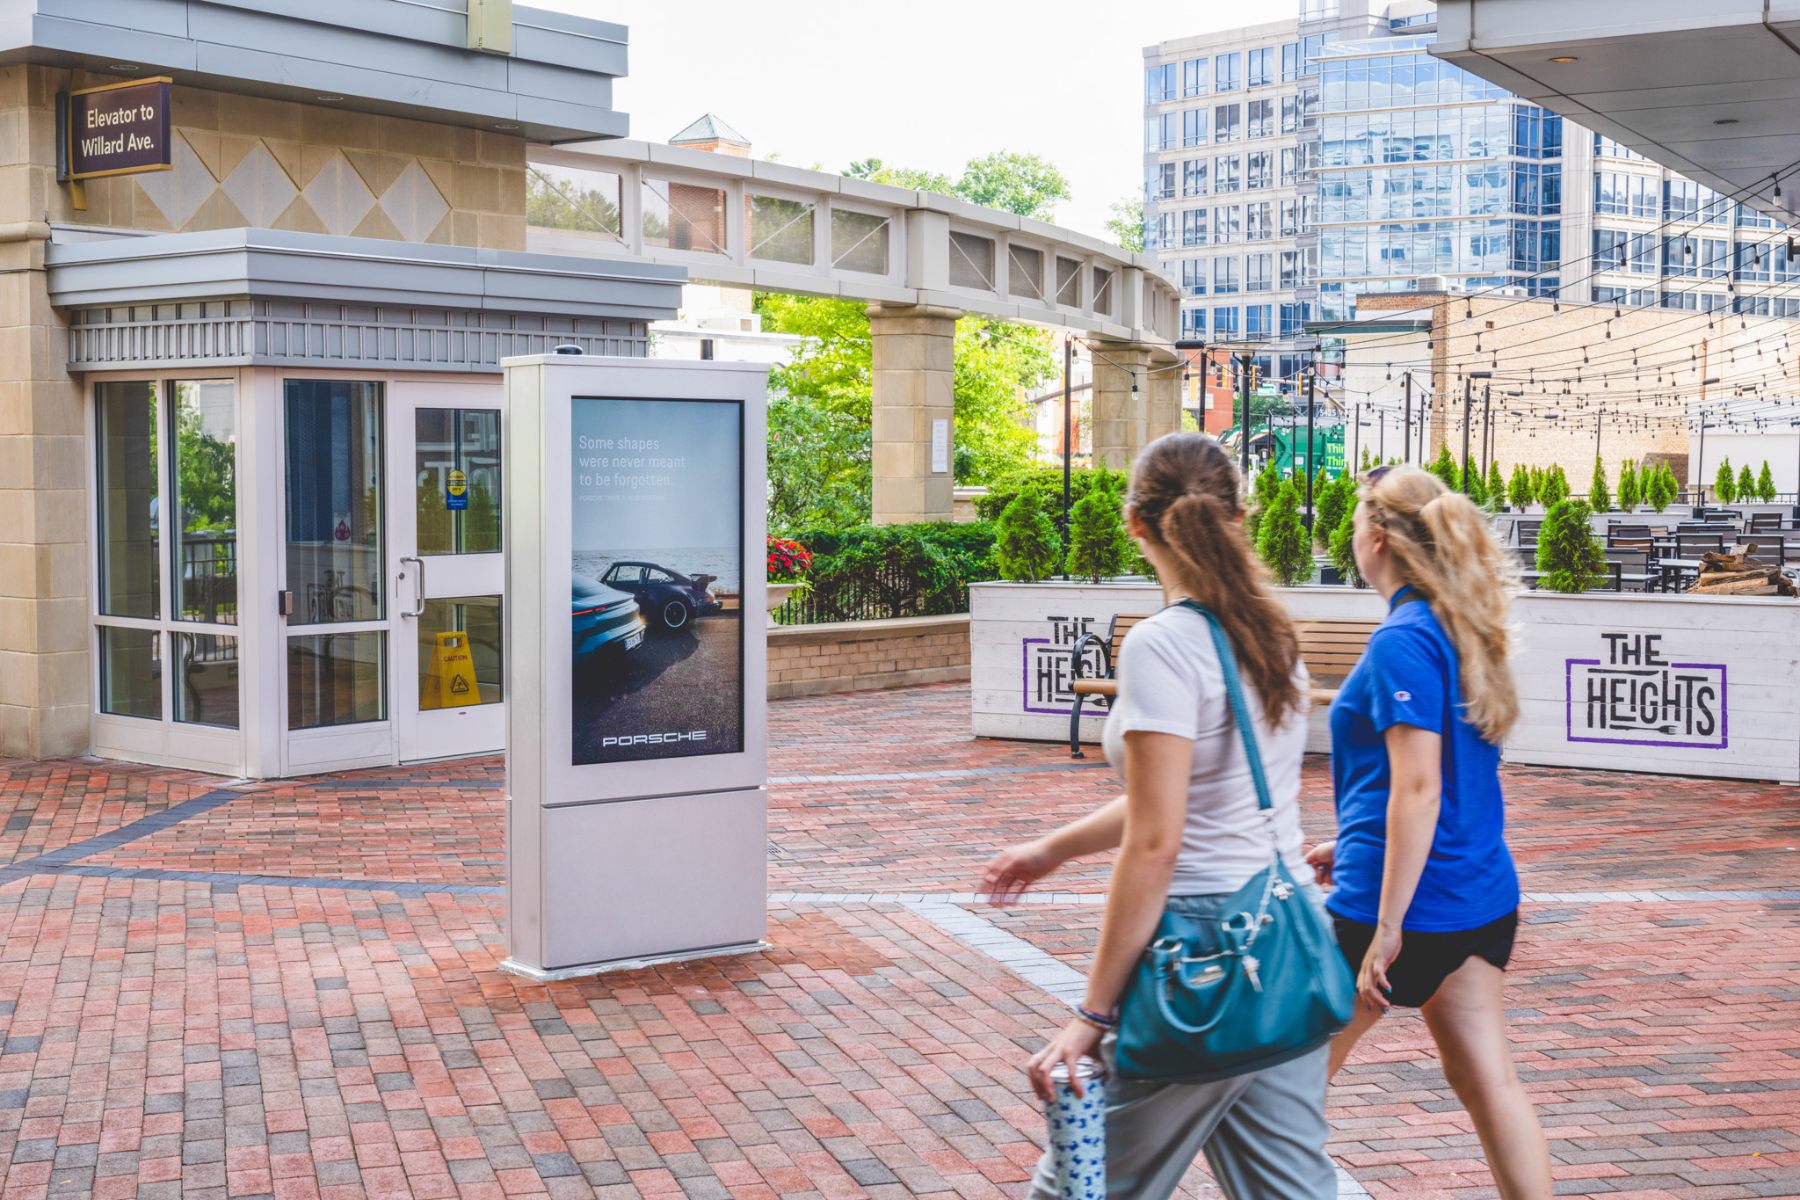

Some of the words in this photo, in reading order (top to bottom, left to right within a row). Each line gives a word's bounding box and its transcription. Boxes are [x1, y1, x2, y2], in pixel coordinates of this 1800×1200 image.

[87, 108, 138, 129] Elevator
[140, 104, 154, 121] to
[81, 133, 124, 157] Willard
[127, 133, 154, 152] Ave.
[579, 435, 614, 450] Some
[617, 436, 660, 452] shapes
[579, 457, 609, 468] were
[612, 457, 645, 468] never
[648, 457, 686, 469] meant
[579, 473, 592, 486] to
[596, 472, 611, 486] be
[1047, 615, 1101, 646] THE
[444, 654, 468, 662] CAUTION
[1601, 632, 1669, 666] THE
[1587, 670, 1715, 736] HEIGHTS
[602, 730, 707, 747] PORSCHE
